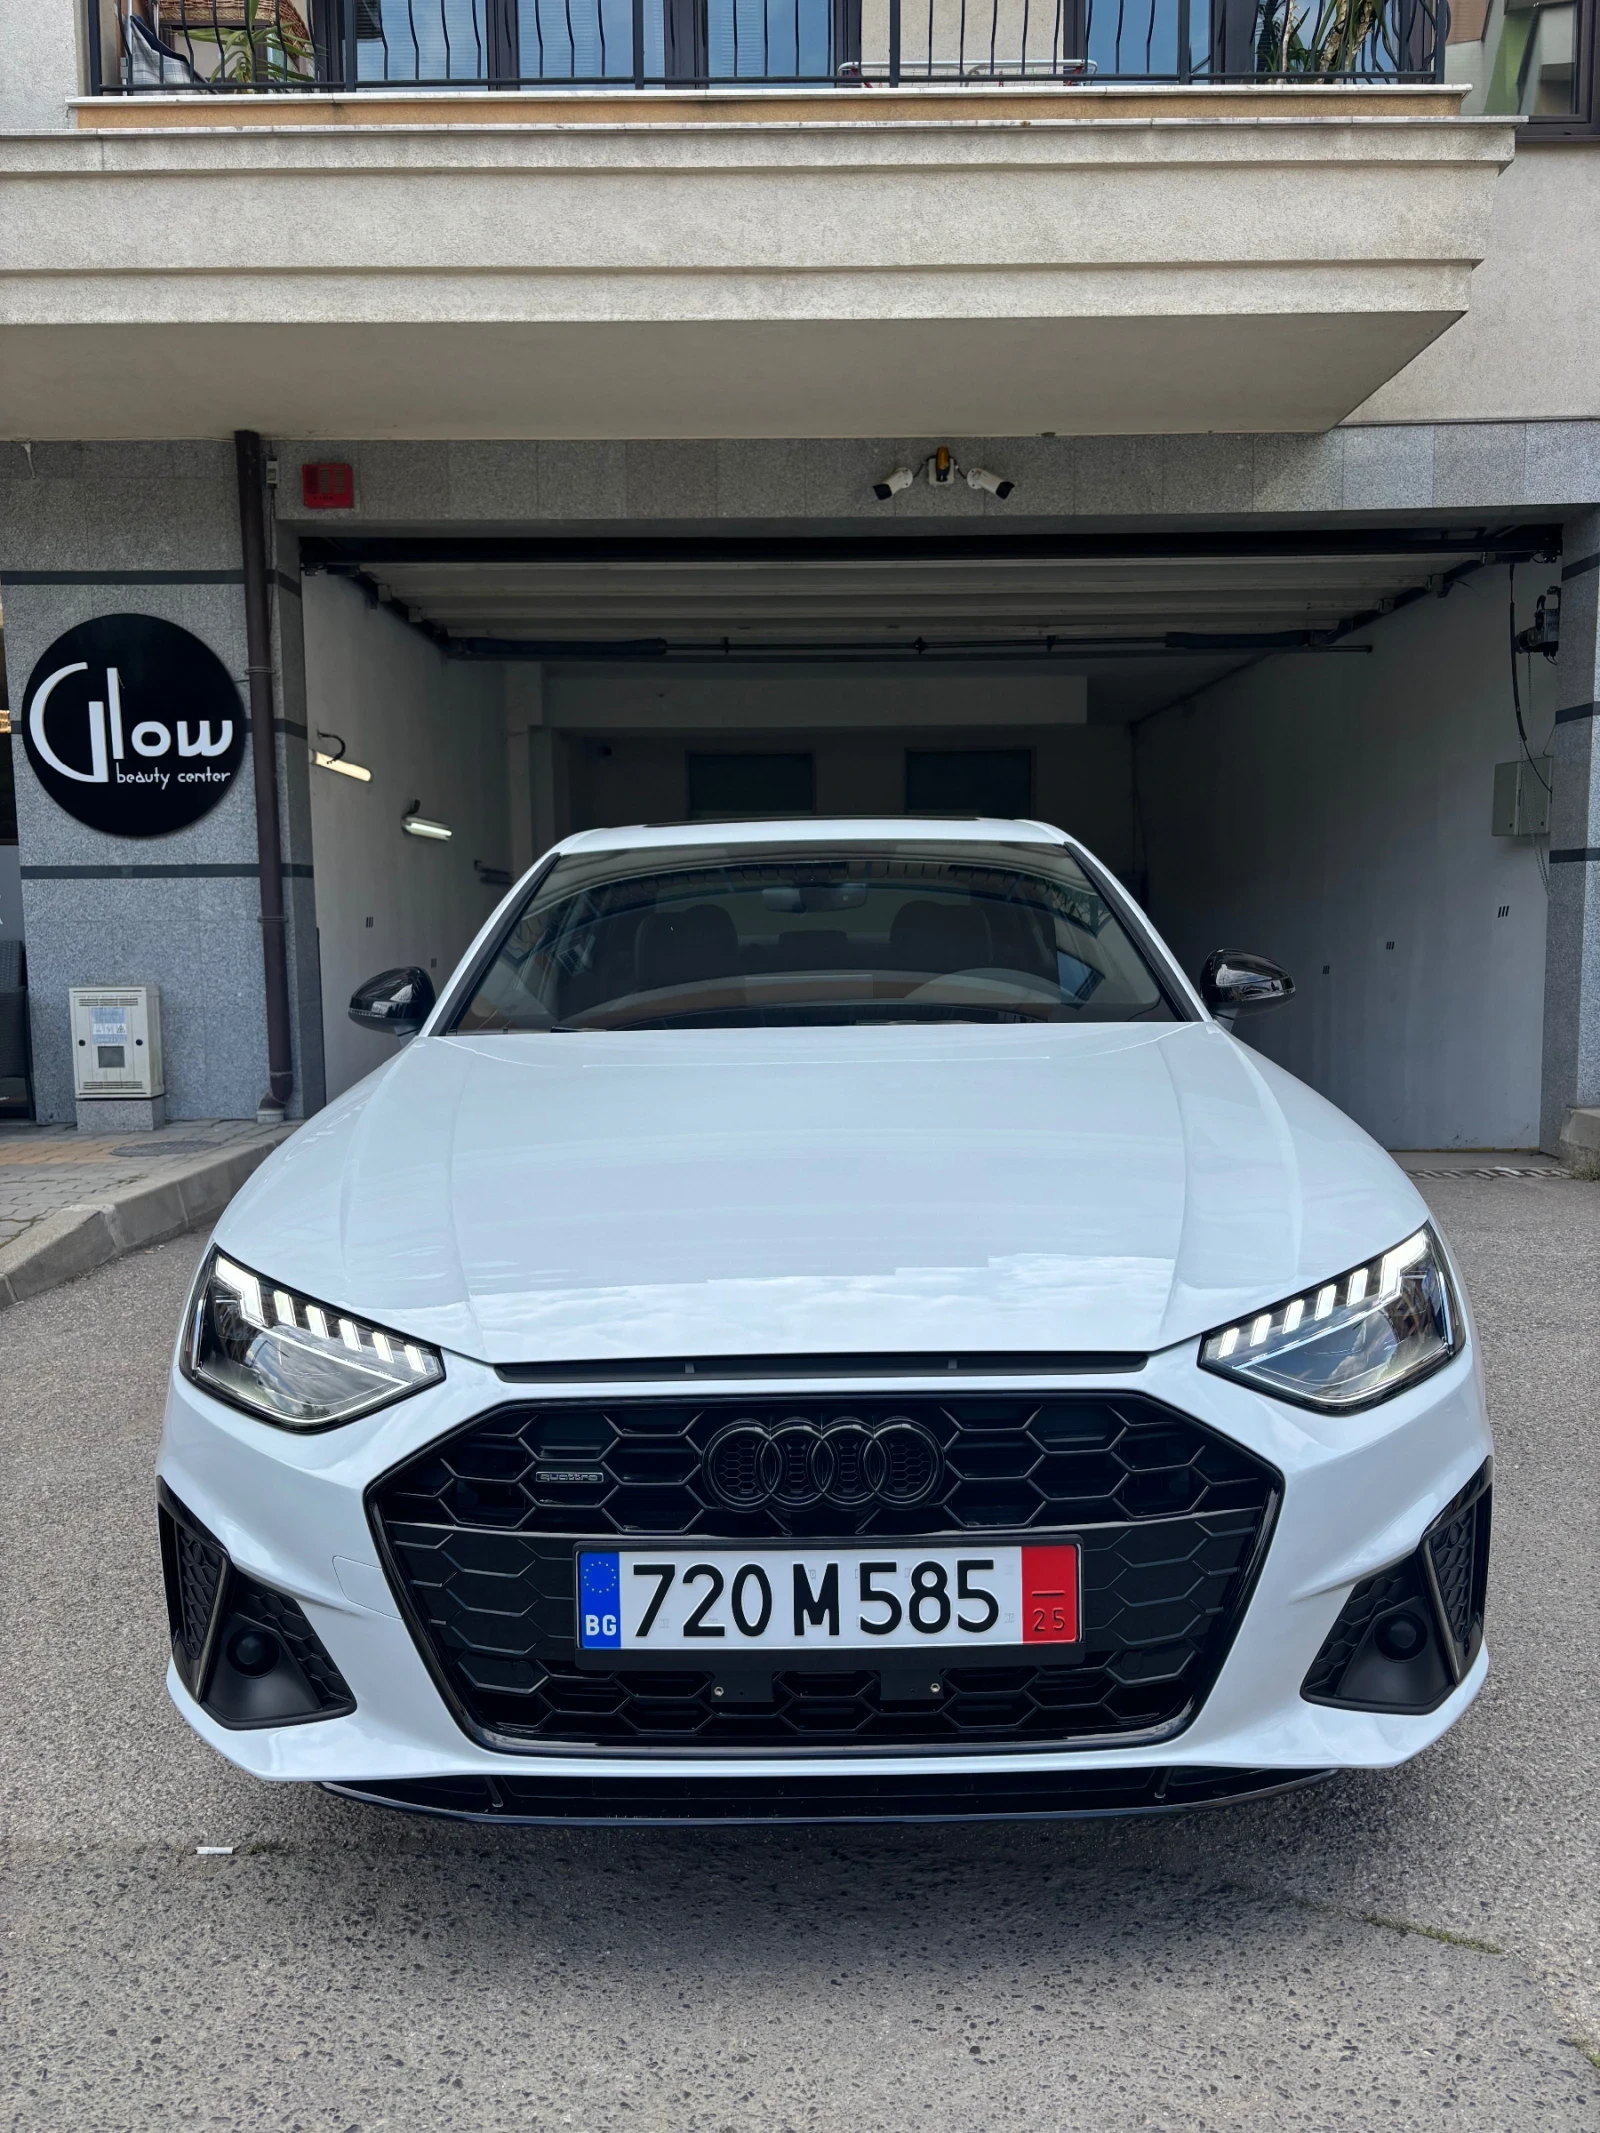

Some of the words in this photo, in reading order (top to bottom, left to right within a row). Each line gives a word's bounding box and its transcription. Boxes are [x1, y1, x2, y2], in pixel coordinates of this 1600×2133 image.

[29, 662, 233, 783] Glow
[116, 762, 170, 790] beauty
[177, 766, 231, 782] center
[540, 1473, 598, 1482] quattro
[633, 1562, 773, 1637] 720
[793, 1562, 840, 1636] M
[858, 1559, 1000, 1635] 585
[585, 1614, 617, 1636] BG
[1033, 1607, 1066, 1632] 25
